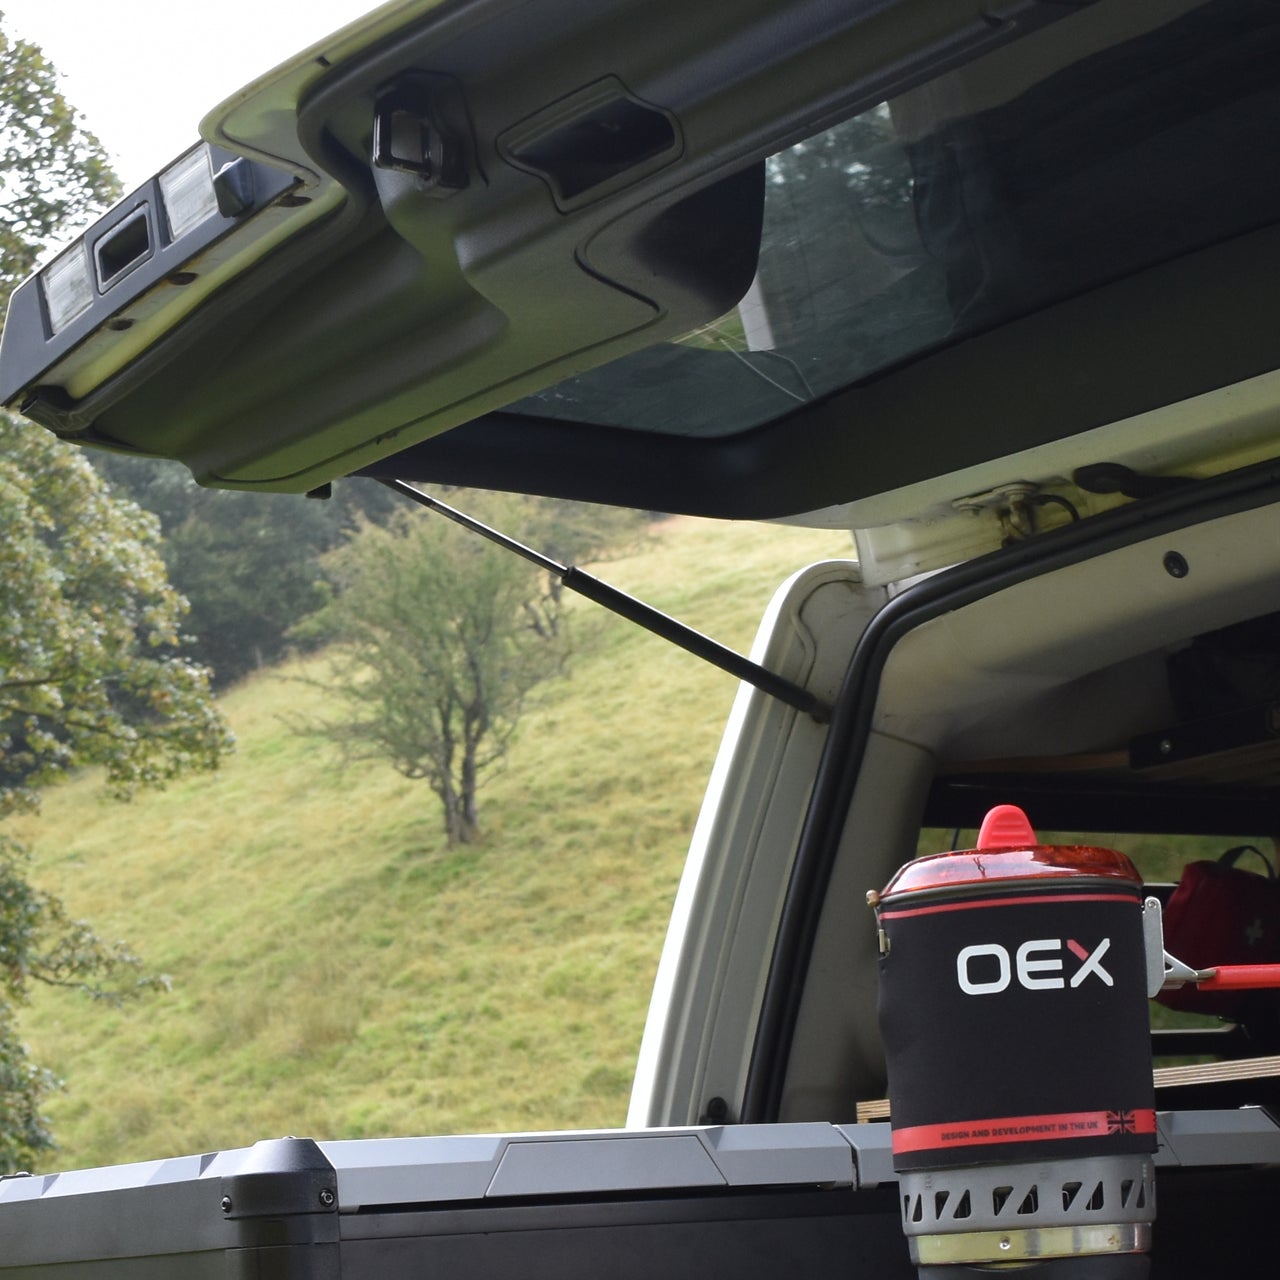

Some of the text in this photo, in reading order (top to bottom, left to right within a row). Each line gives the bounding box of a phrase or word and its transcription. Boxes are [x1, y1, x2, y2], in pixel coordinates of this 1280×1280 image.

[956, 937, 1114, 996] OEX
[941, 1121, 1099, 1141] DESIGN AND DEVELOPMENT IN THE UK
